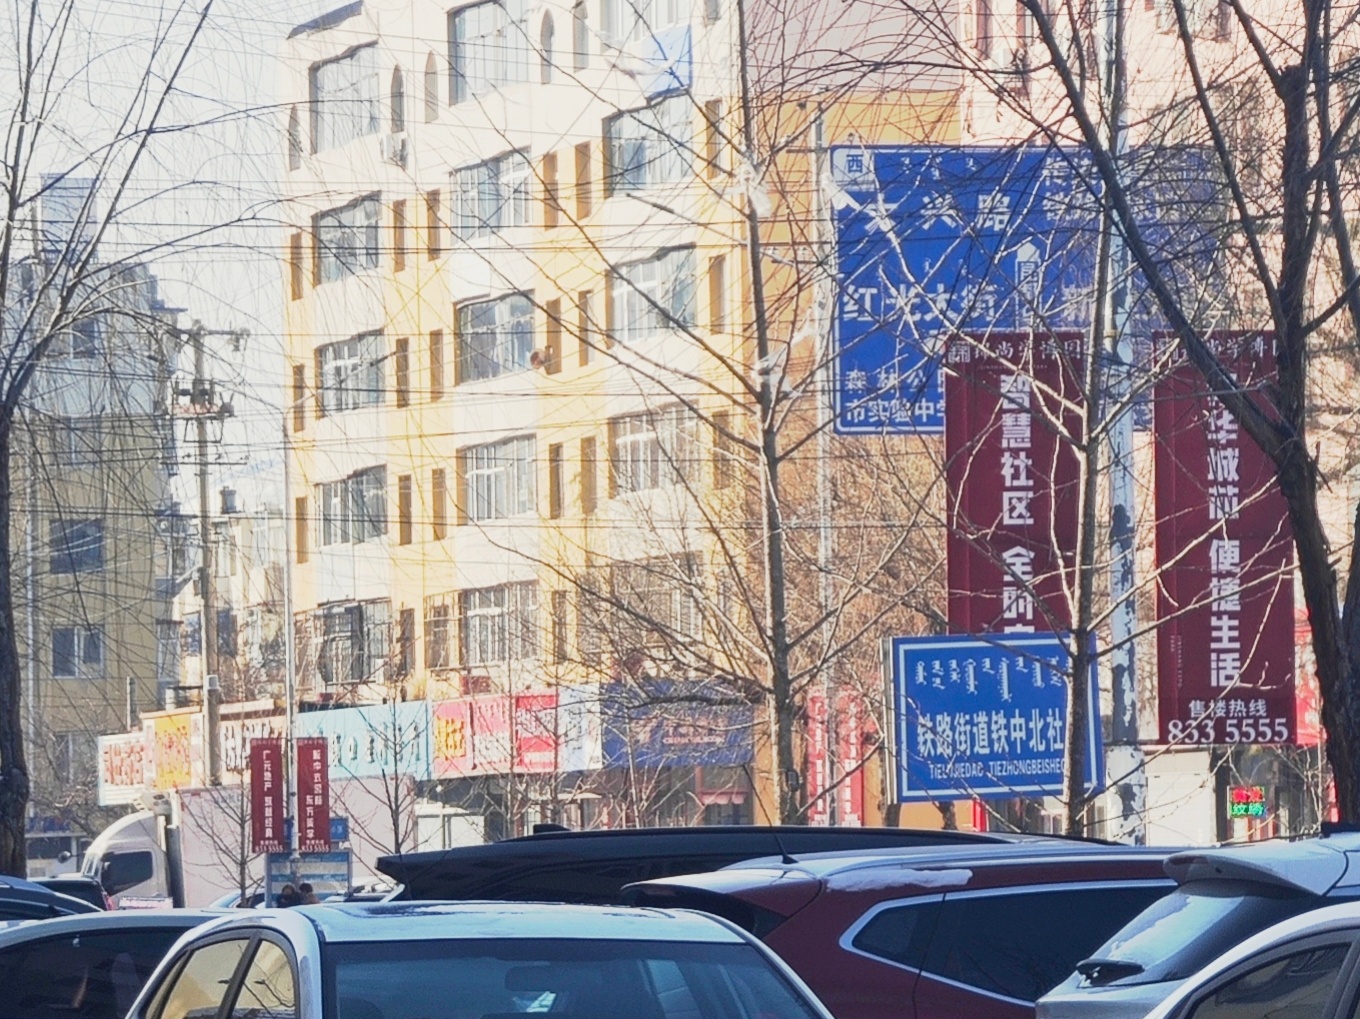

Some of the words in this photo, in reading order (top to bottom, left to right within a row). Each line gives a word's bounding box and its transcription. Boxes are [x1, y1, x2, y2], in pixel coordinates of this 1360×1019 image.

[846, 153, 864, 174] 西
[1000, 373, 1035, 526] 智慧社区
[1206, 373, 1241, 520] 华城芯
[1208, 538, 1242, 688] 便捷生活
[917, 706, 1065, 758] 铁路街道铁中北社
[1167, 720, 1215, 744] 833
[1225, 717, 1289, 743] 5555
[1188, 699, 1267, 718] 售楼热线
